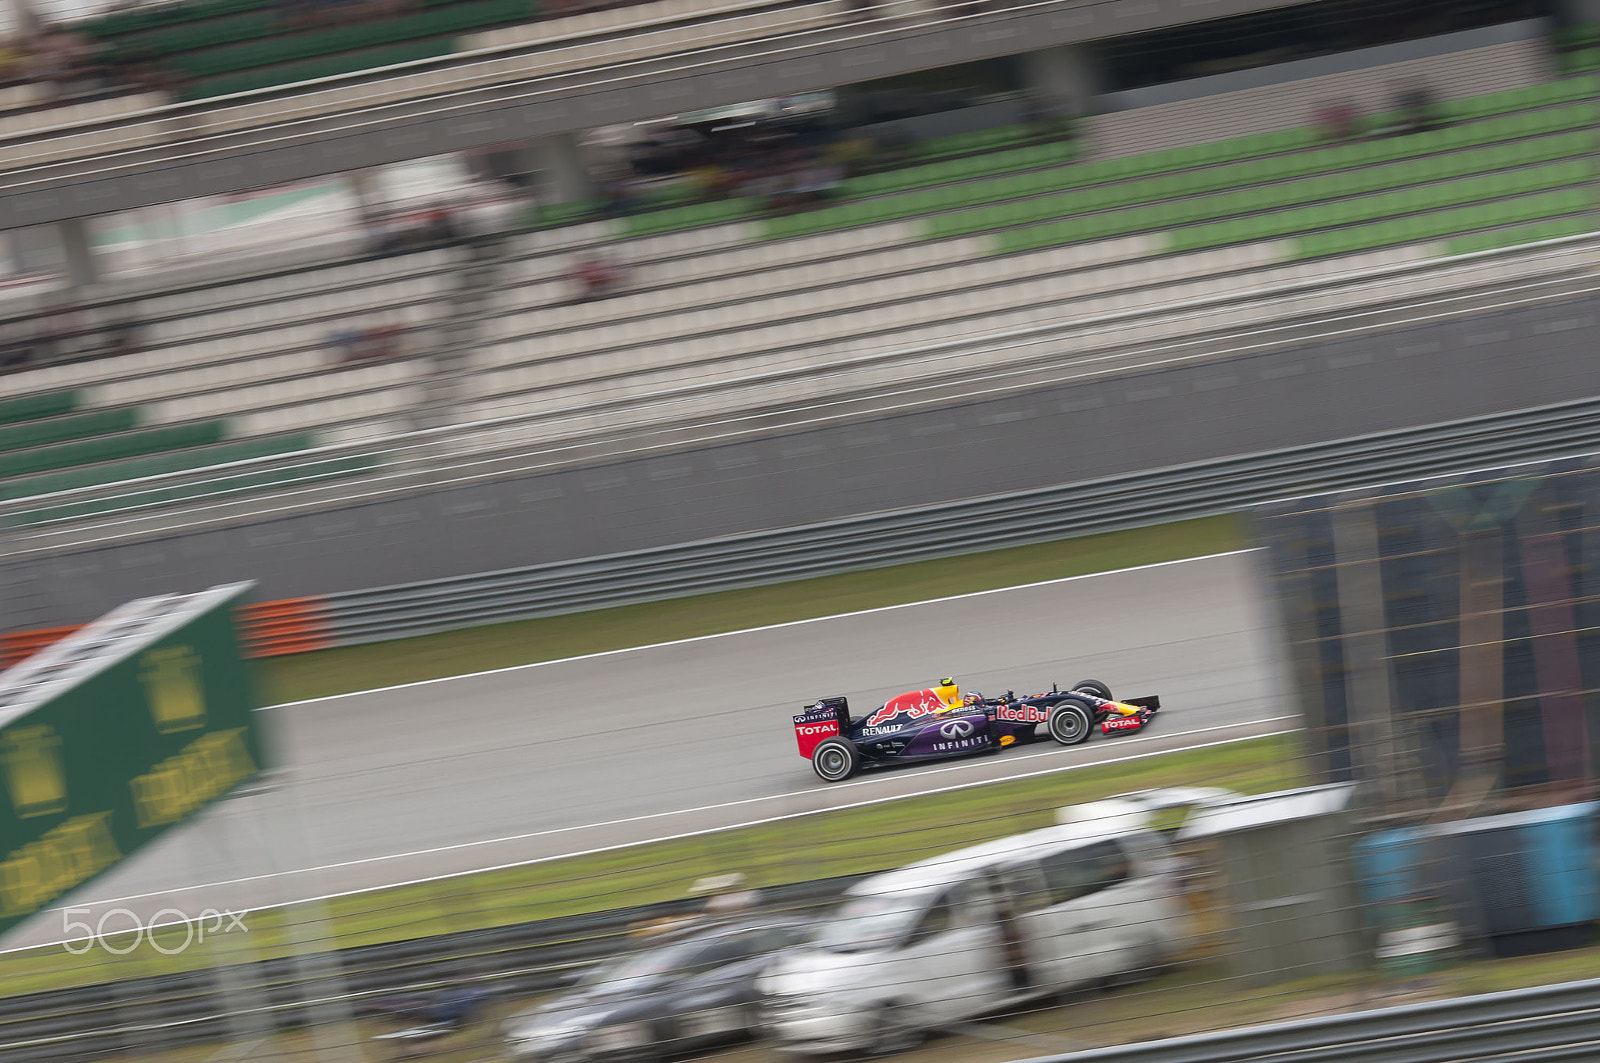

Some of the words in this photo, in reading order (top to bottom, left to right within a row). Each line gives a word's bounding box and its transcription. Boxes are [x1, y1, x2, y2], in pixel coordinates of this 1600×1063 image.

[862, 723, 902, 736] RENAULT
[1103, 719, 1140, 728] TOTAL
[795, 724, 837, 736] TOTAL
[932, 734, 989, 751] INFINITI
